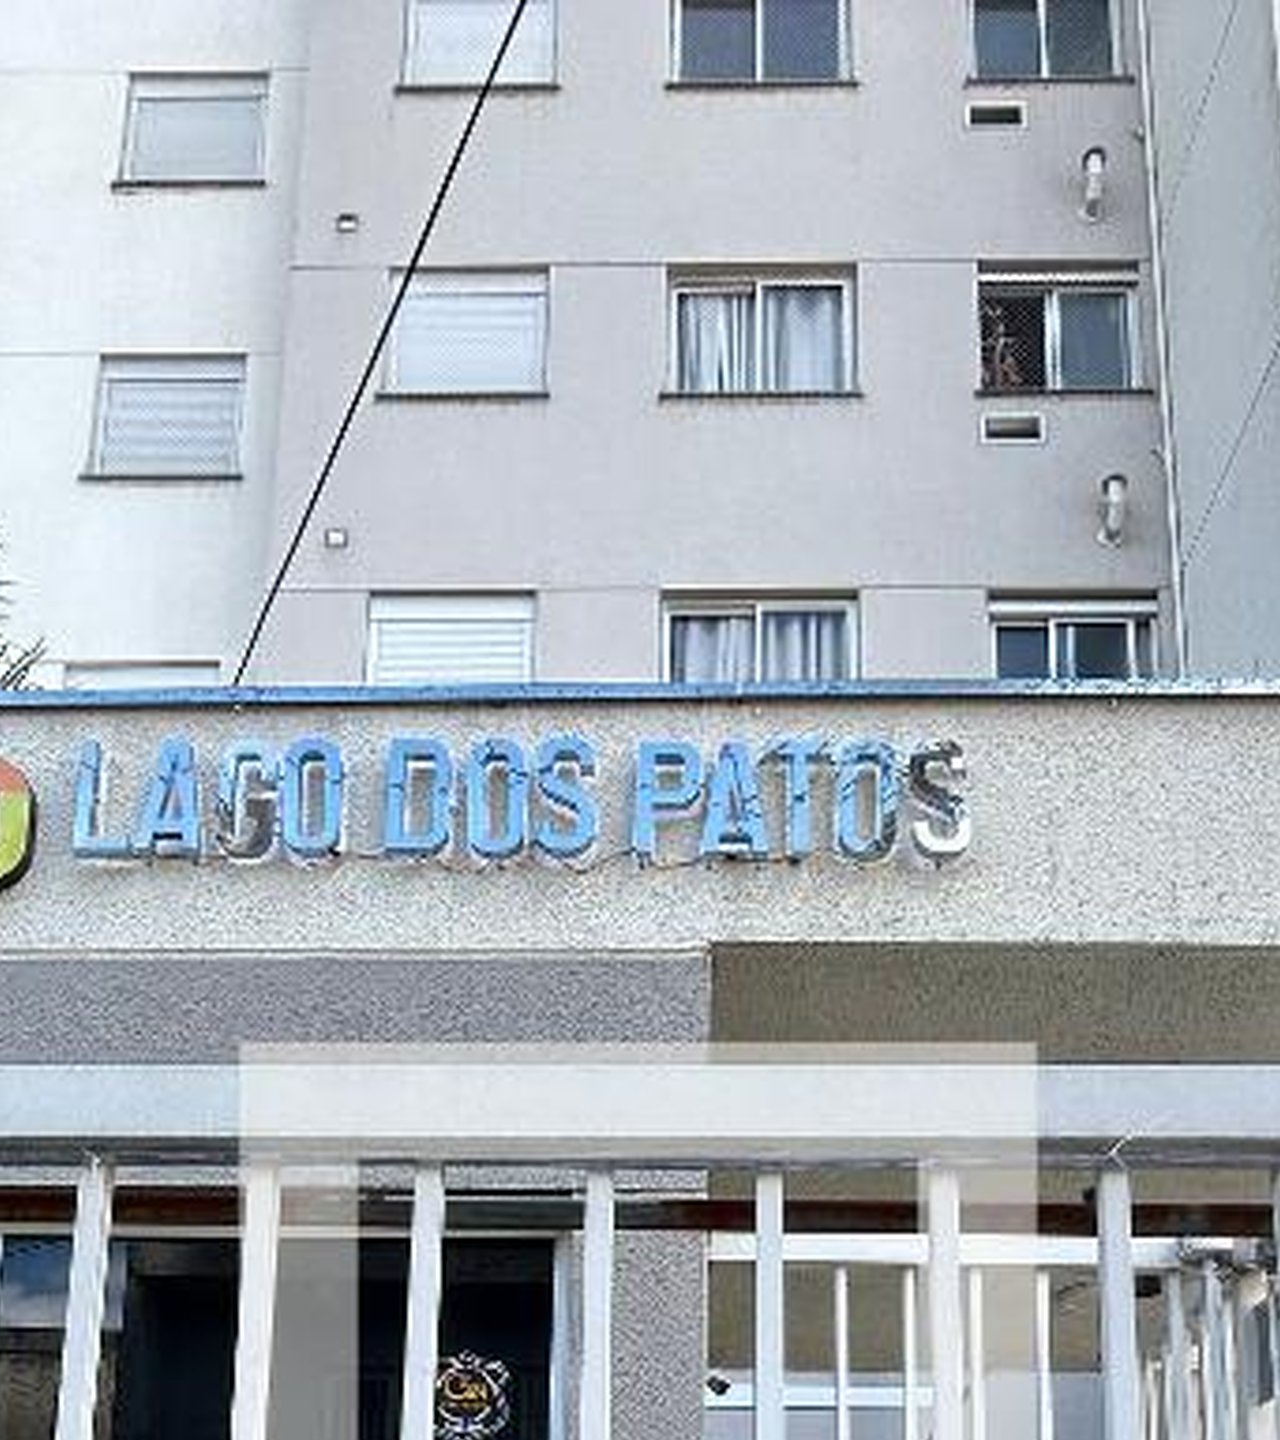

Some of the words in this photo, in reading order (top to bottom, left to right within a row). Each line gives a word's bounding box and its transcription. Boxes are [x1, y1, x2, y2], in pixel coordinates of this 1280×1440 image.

[72, 735, 344, 860] LAGO
[383, 732, 600, 860] DOS
[631, 733, 973, 860] PATOS
